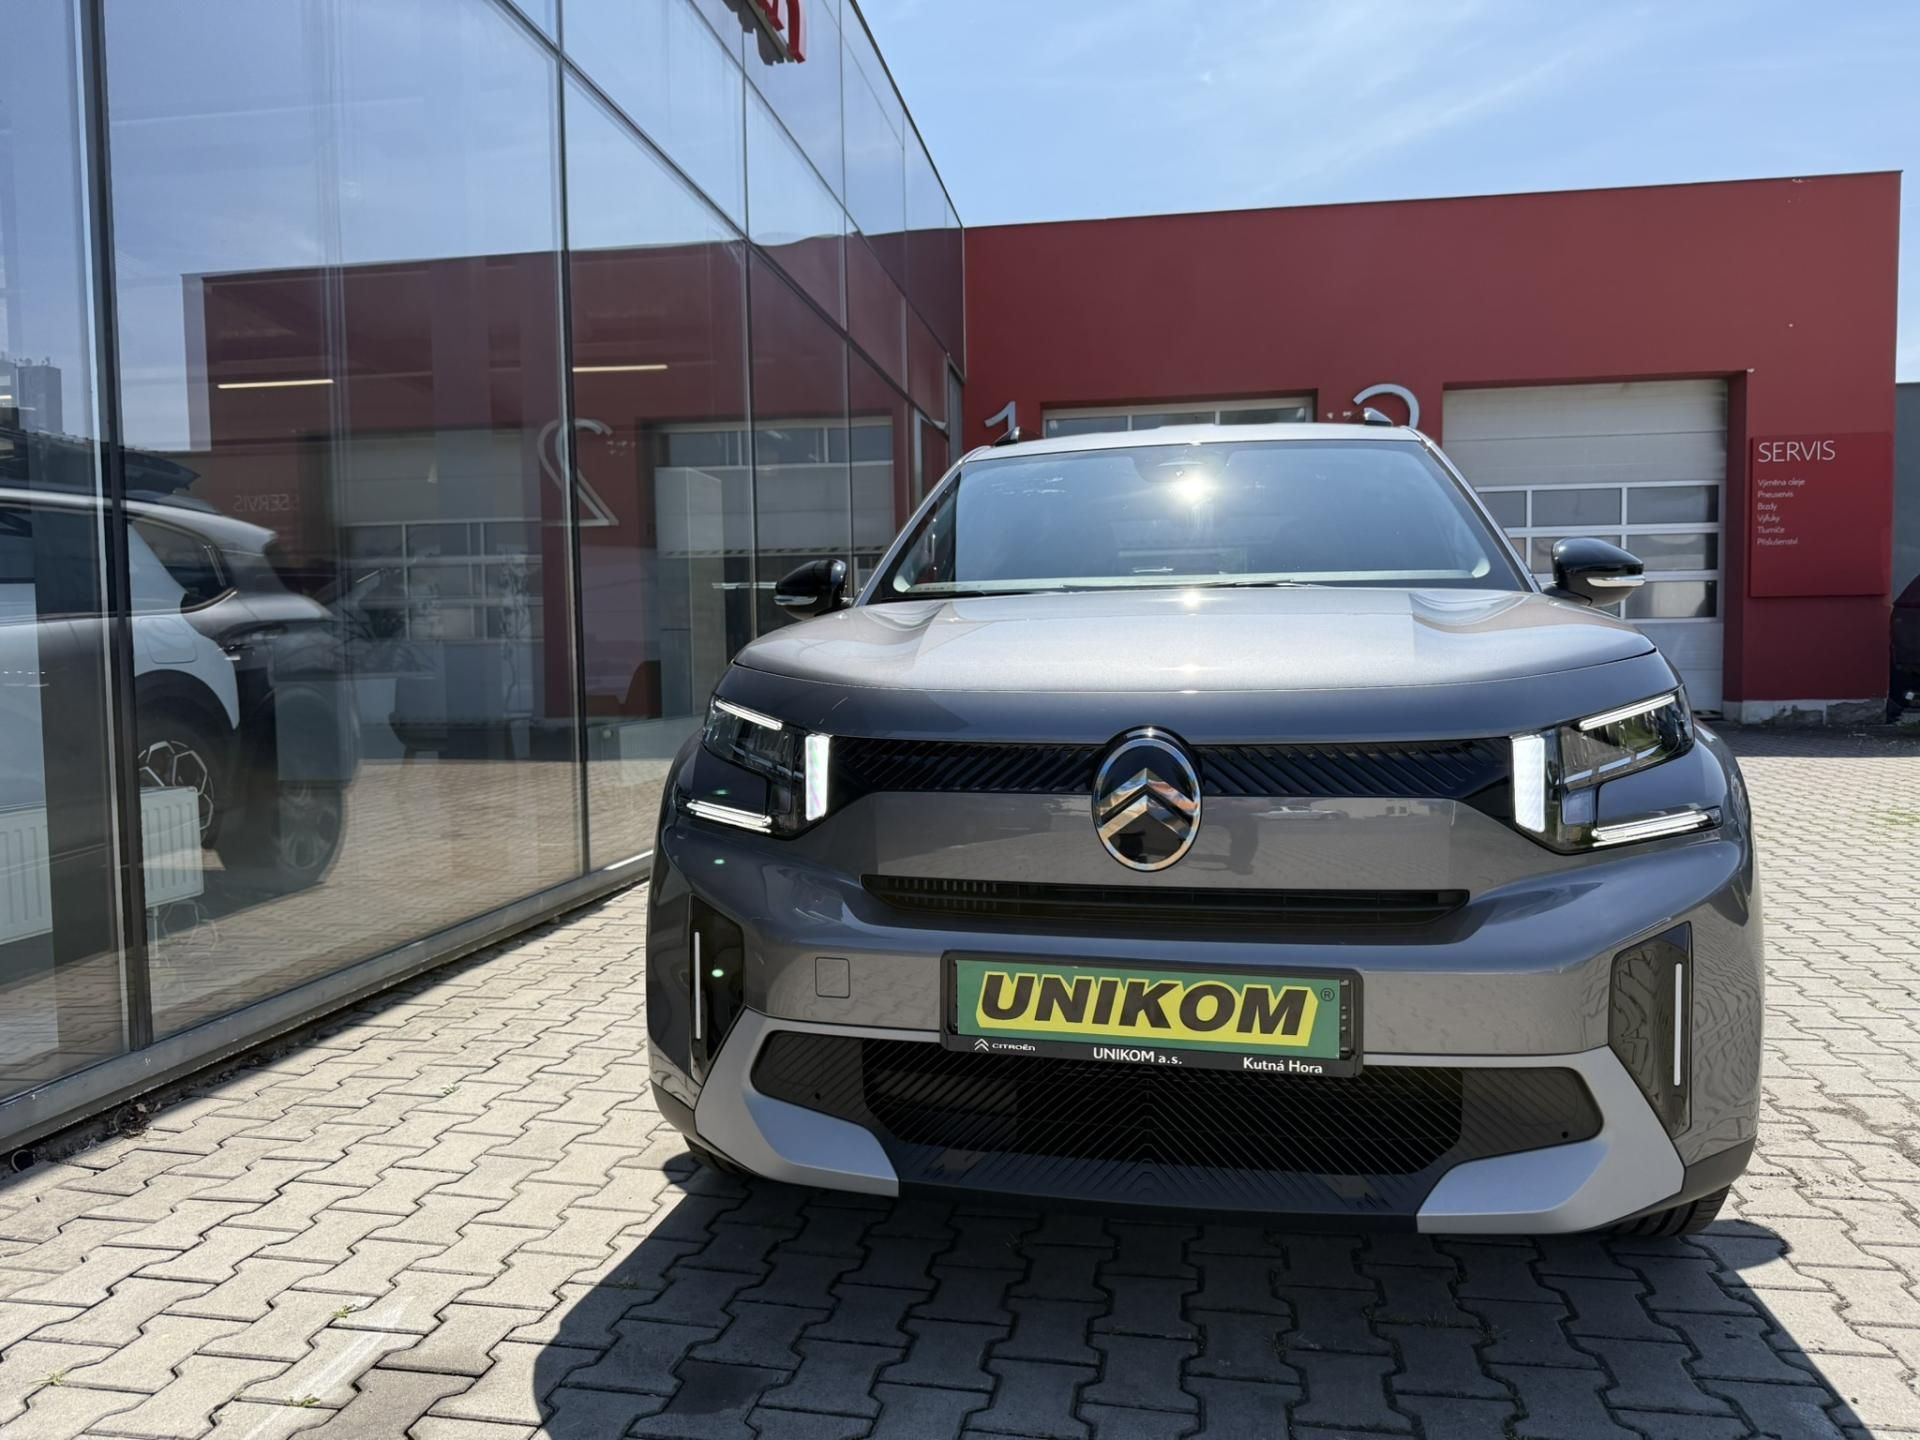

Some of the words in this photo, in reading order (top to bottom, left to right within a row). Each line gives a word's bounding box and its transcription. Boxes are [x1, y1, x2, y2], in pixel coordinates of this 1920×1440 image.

[1757, 440, 1836, 463] SERVIS
[981, 974, 1308, 1036] UNIKOM
[1093, 1047, 1155, 1063] UNIKOM
[1158, 1054, 1183, 1065] a.s.
[1243, 1057, 1285, 1072] Kutná
[1288, 1060, 1323, 1074] Hora
